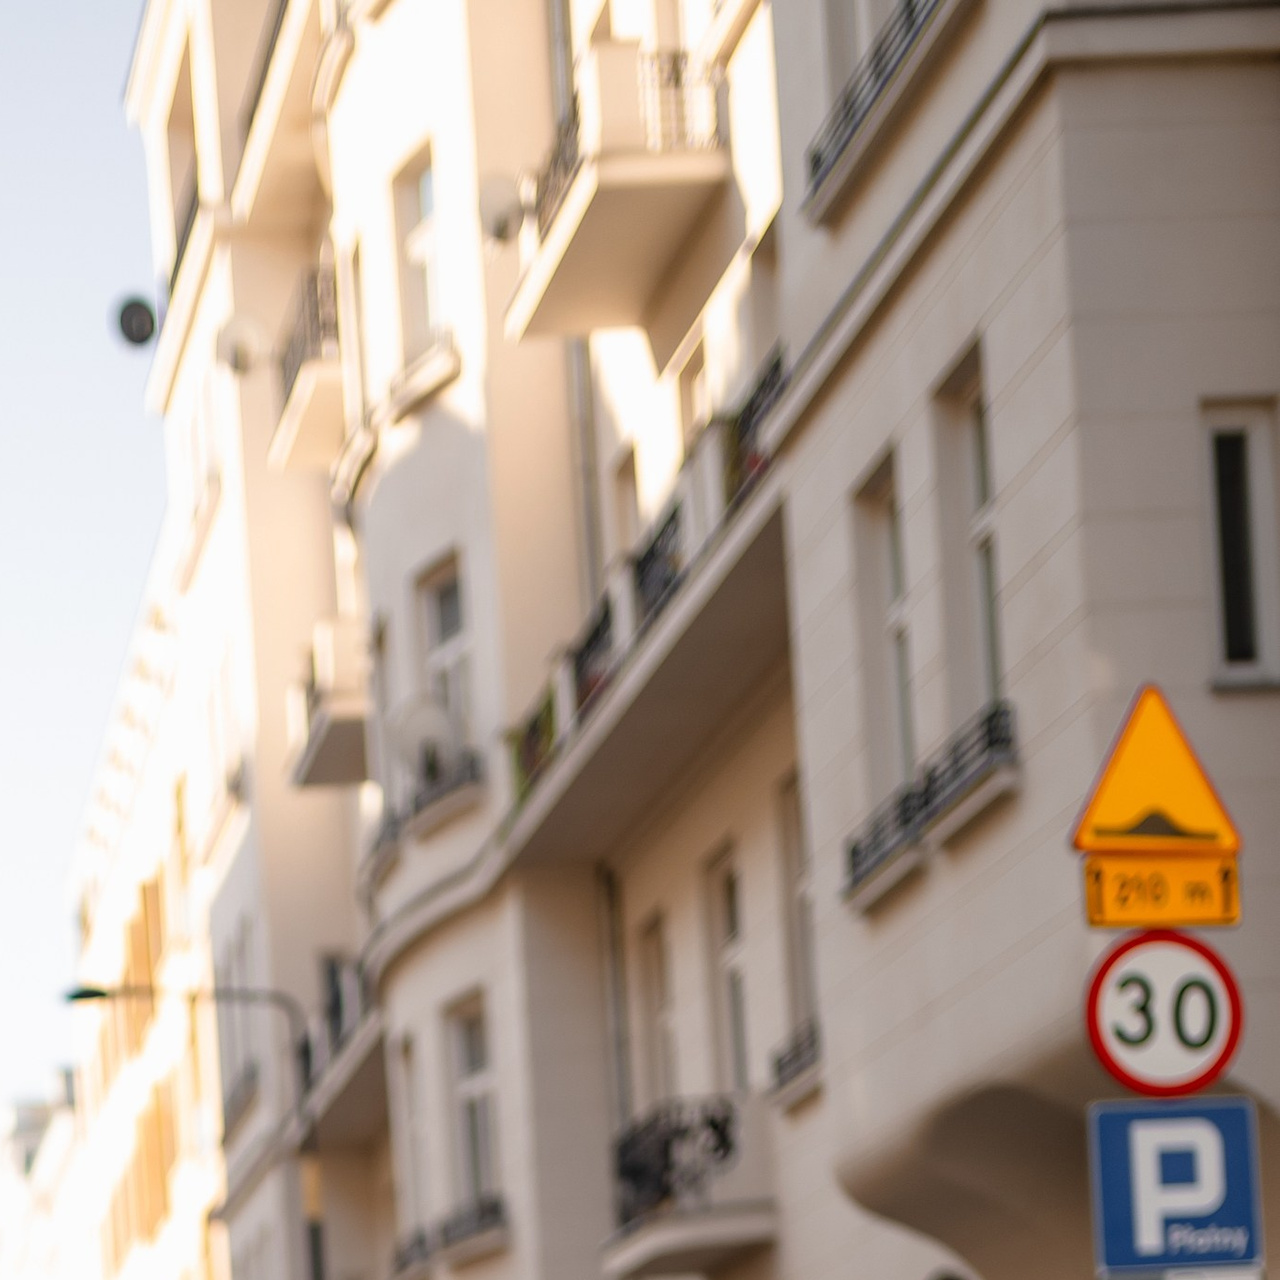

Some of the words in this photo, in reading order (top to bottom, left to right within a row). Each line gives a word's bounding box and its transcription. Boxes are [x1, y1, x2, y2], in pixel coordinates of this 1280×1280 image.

[1184, 881, 1217, 907] m
[1113, 975, 1219, 1049] 30
[1129, 1117, 1226, 1256] P
